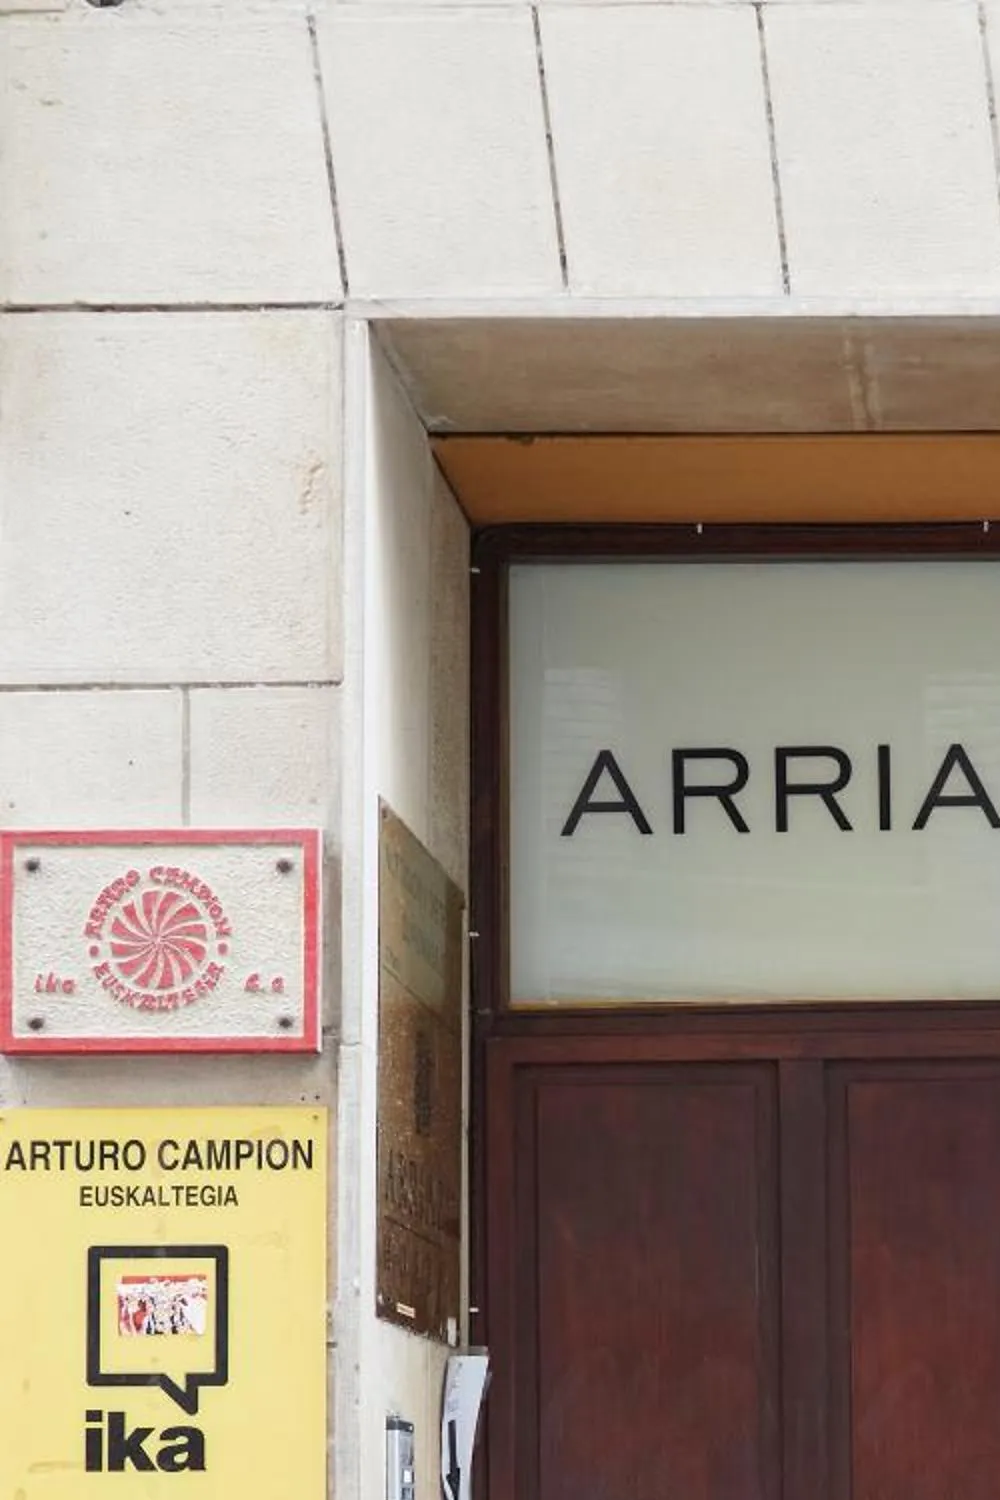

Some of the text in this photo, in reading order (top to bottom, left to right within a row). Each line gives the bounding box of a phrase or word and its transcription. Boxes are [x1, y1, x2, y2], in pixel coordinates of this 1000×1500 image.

[5, 1139, 314, 1171] ARTURO CAMPION
[79, 1185, 239, 1207] EUSKALTEGIA
[85, 1409, 207, 1473] ika
